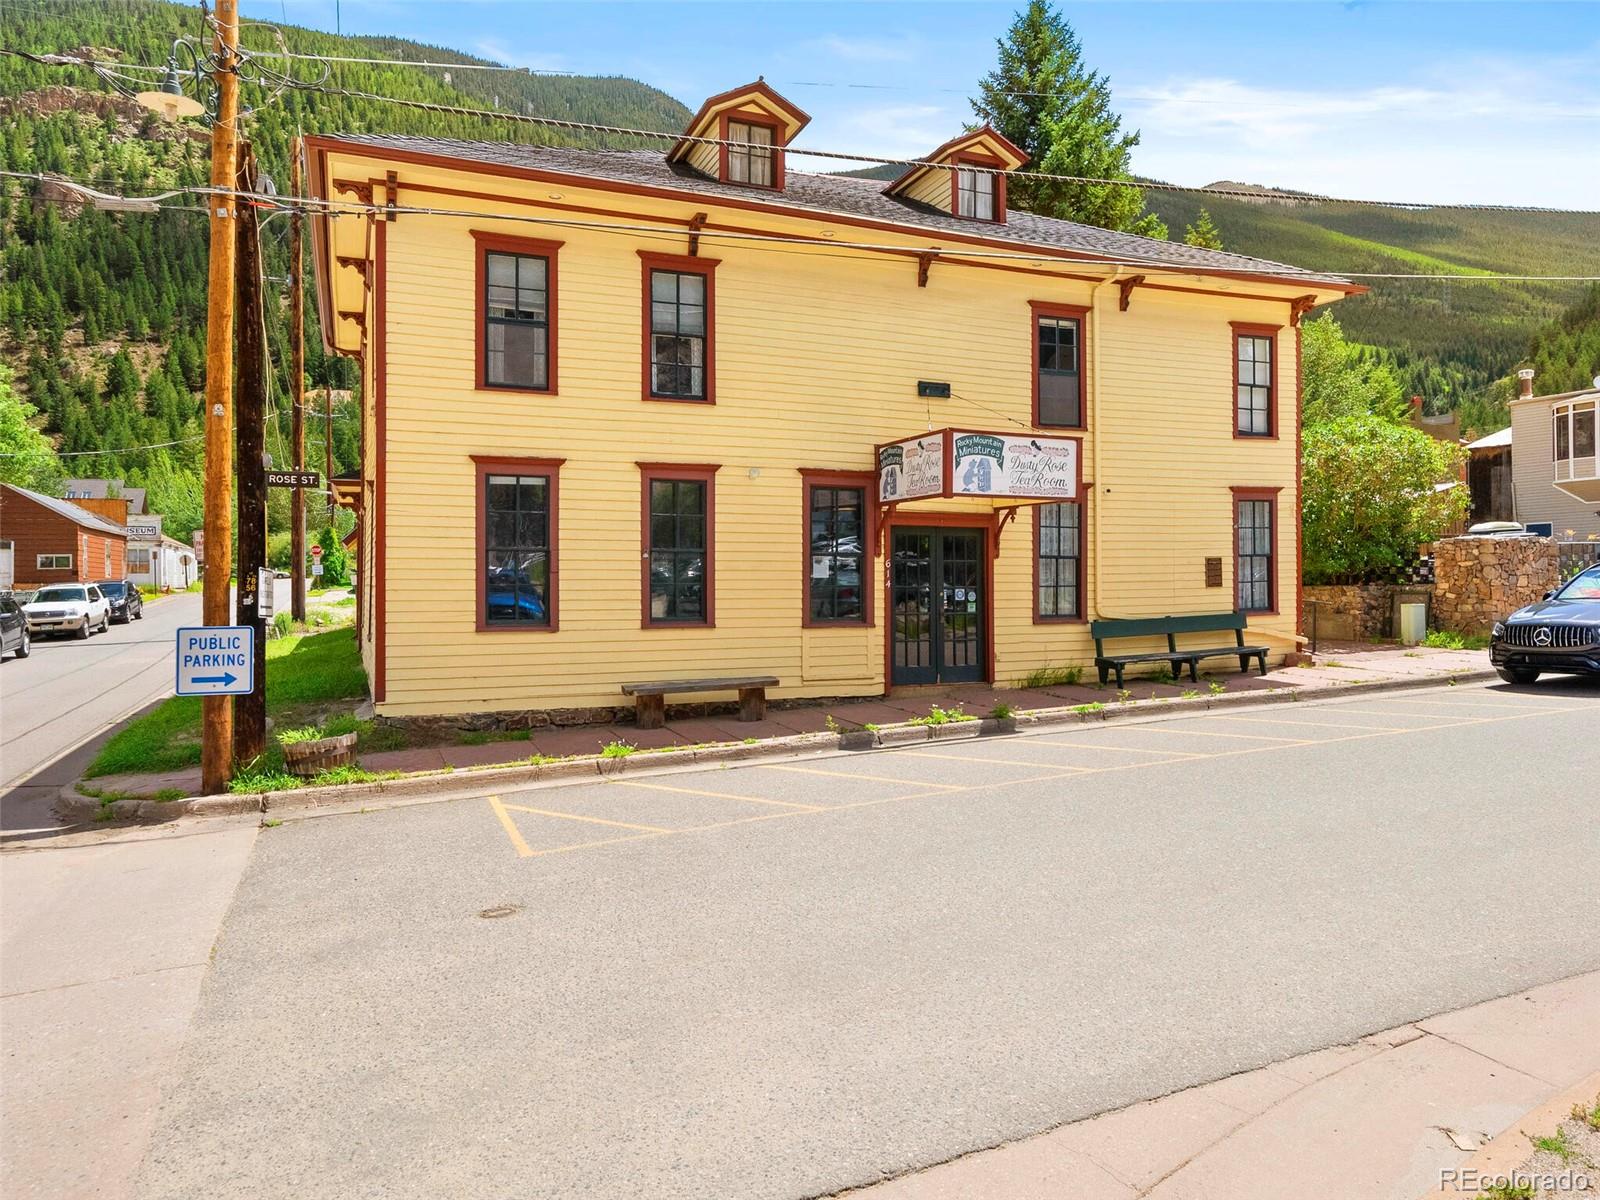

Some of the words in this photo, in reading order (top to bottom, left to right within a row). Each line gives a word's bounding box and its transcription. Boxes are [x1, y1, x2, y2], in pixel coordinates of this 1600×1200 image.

[973, 436, 1002, 448] Mountain
[958, 445, 1001, 458] Miniatures
[1008, 455, 1038, 474] Dusty
[1038, 456, 1068, 473] Rose
[268, 474, 298, 484] ROSE
[301, 475, 318, 485] ST.
[1009, 470, 1031, 485] Tea
[189, 636, 241, 650] PUBLIC
[184, 653, 245, 667] PARKING
